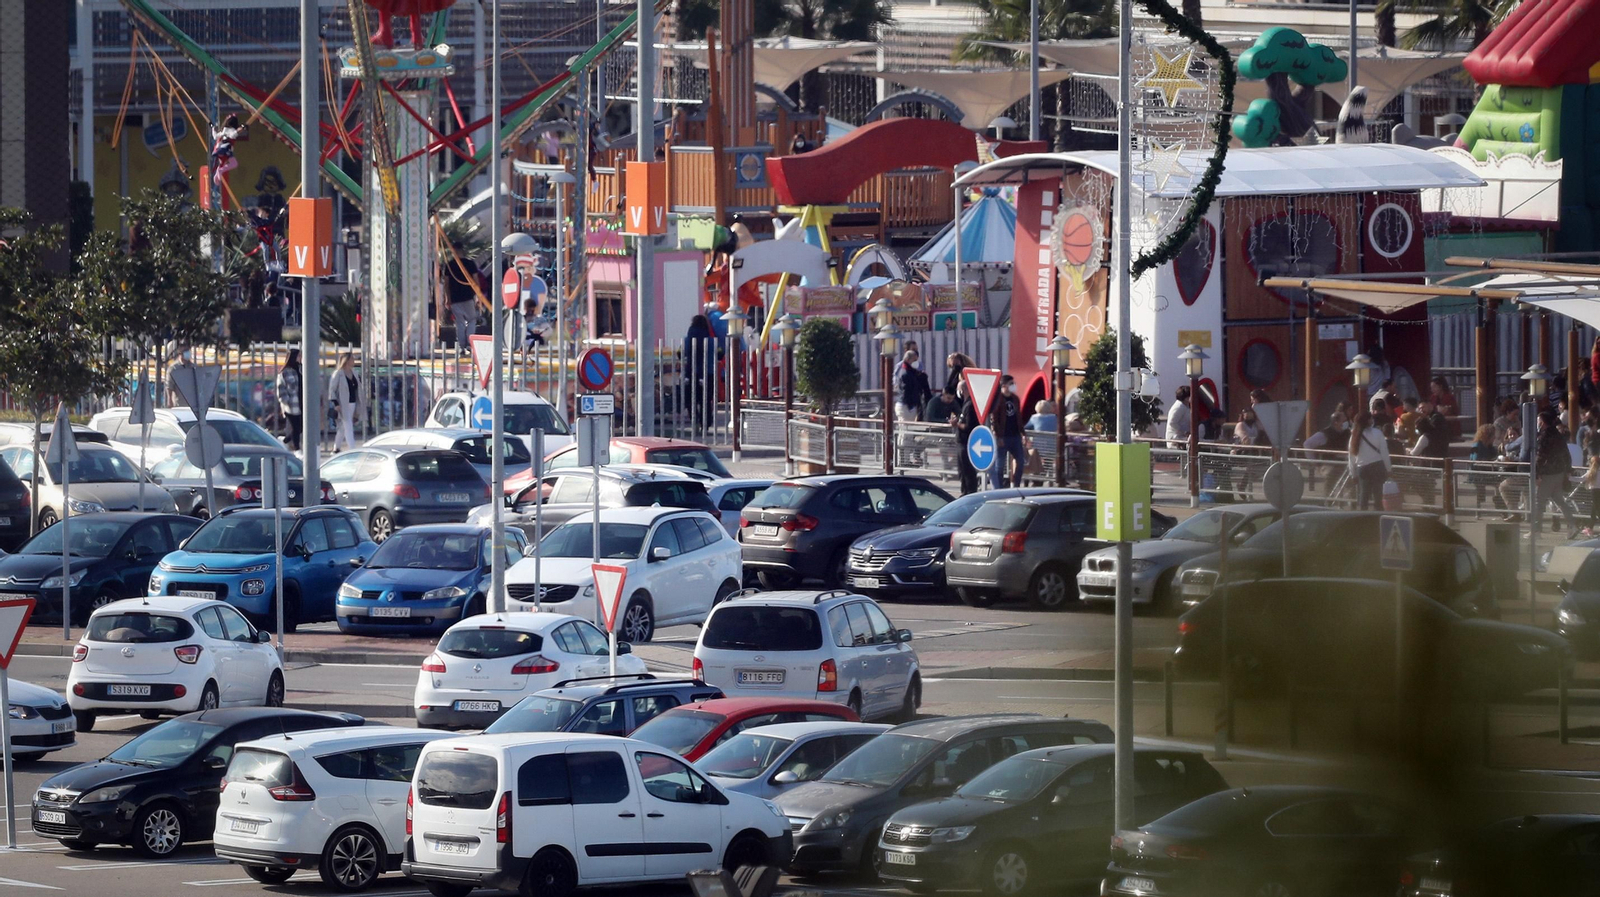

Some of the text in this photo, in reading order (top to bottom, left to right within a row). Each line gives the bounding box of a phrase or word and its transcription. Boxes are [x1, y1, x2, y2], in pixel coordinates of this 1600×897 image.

[630, 206, 643, 228] V
[654, 206, 663, 228] V
[294, 245, 309, 269] V
[321, 246, 329, 269] V
[1037, 267, 1050, 335] ENTRADA
[1104, 501, 1114, 530] E
[1133, 502, 1144, 531] E
[374, 608, 392, 616] 0135
[743, 673, 764, 681] 8116
[112, 685, 149, 696] 5319 KXG
[460, 701, 498, 711] 0766 HKC
[440, 842, 454, 852] 1956
[888, 853, 902, 863] 7173
